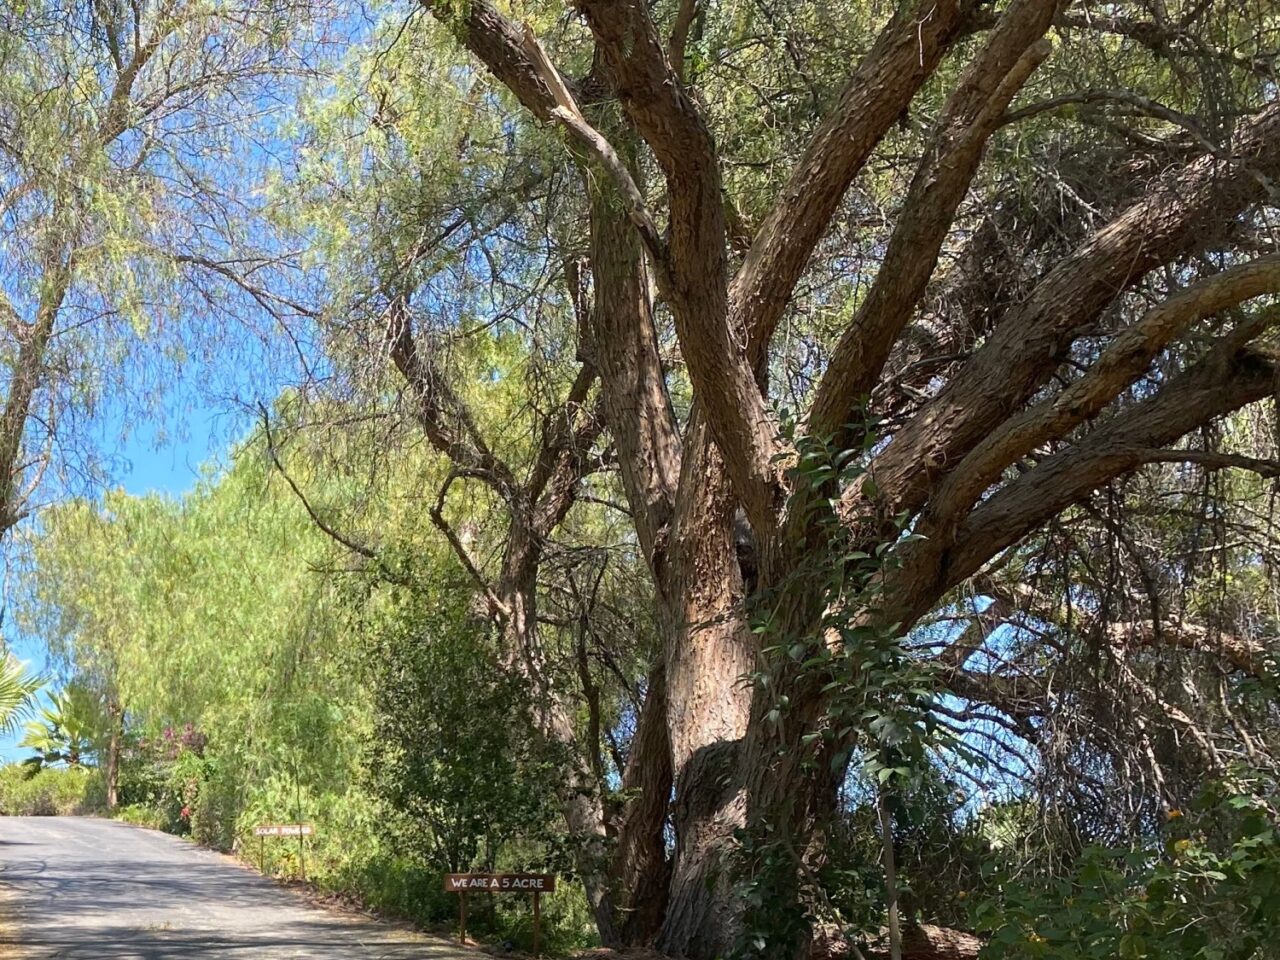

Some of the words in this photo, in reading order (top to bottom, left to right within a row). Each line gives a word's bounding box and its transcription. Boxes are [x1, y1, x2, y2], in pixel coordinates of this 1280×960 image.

[451, 878, 468, 888] WE
[469, 878, 488, 888] ARE
[490, 878, 499, 887] A
[502, 878, 510, 888] 5
[512, 878, 544, 888] ACRE
